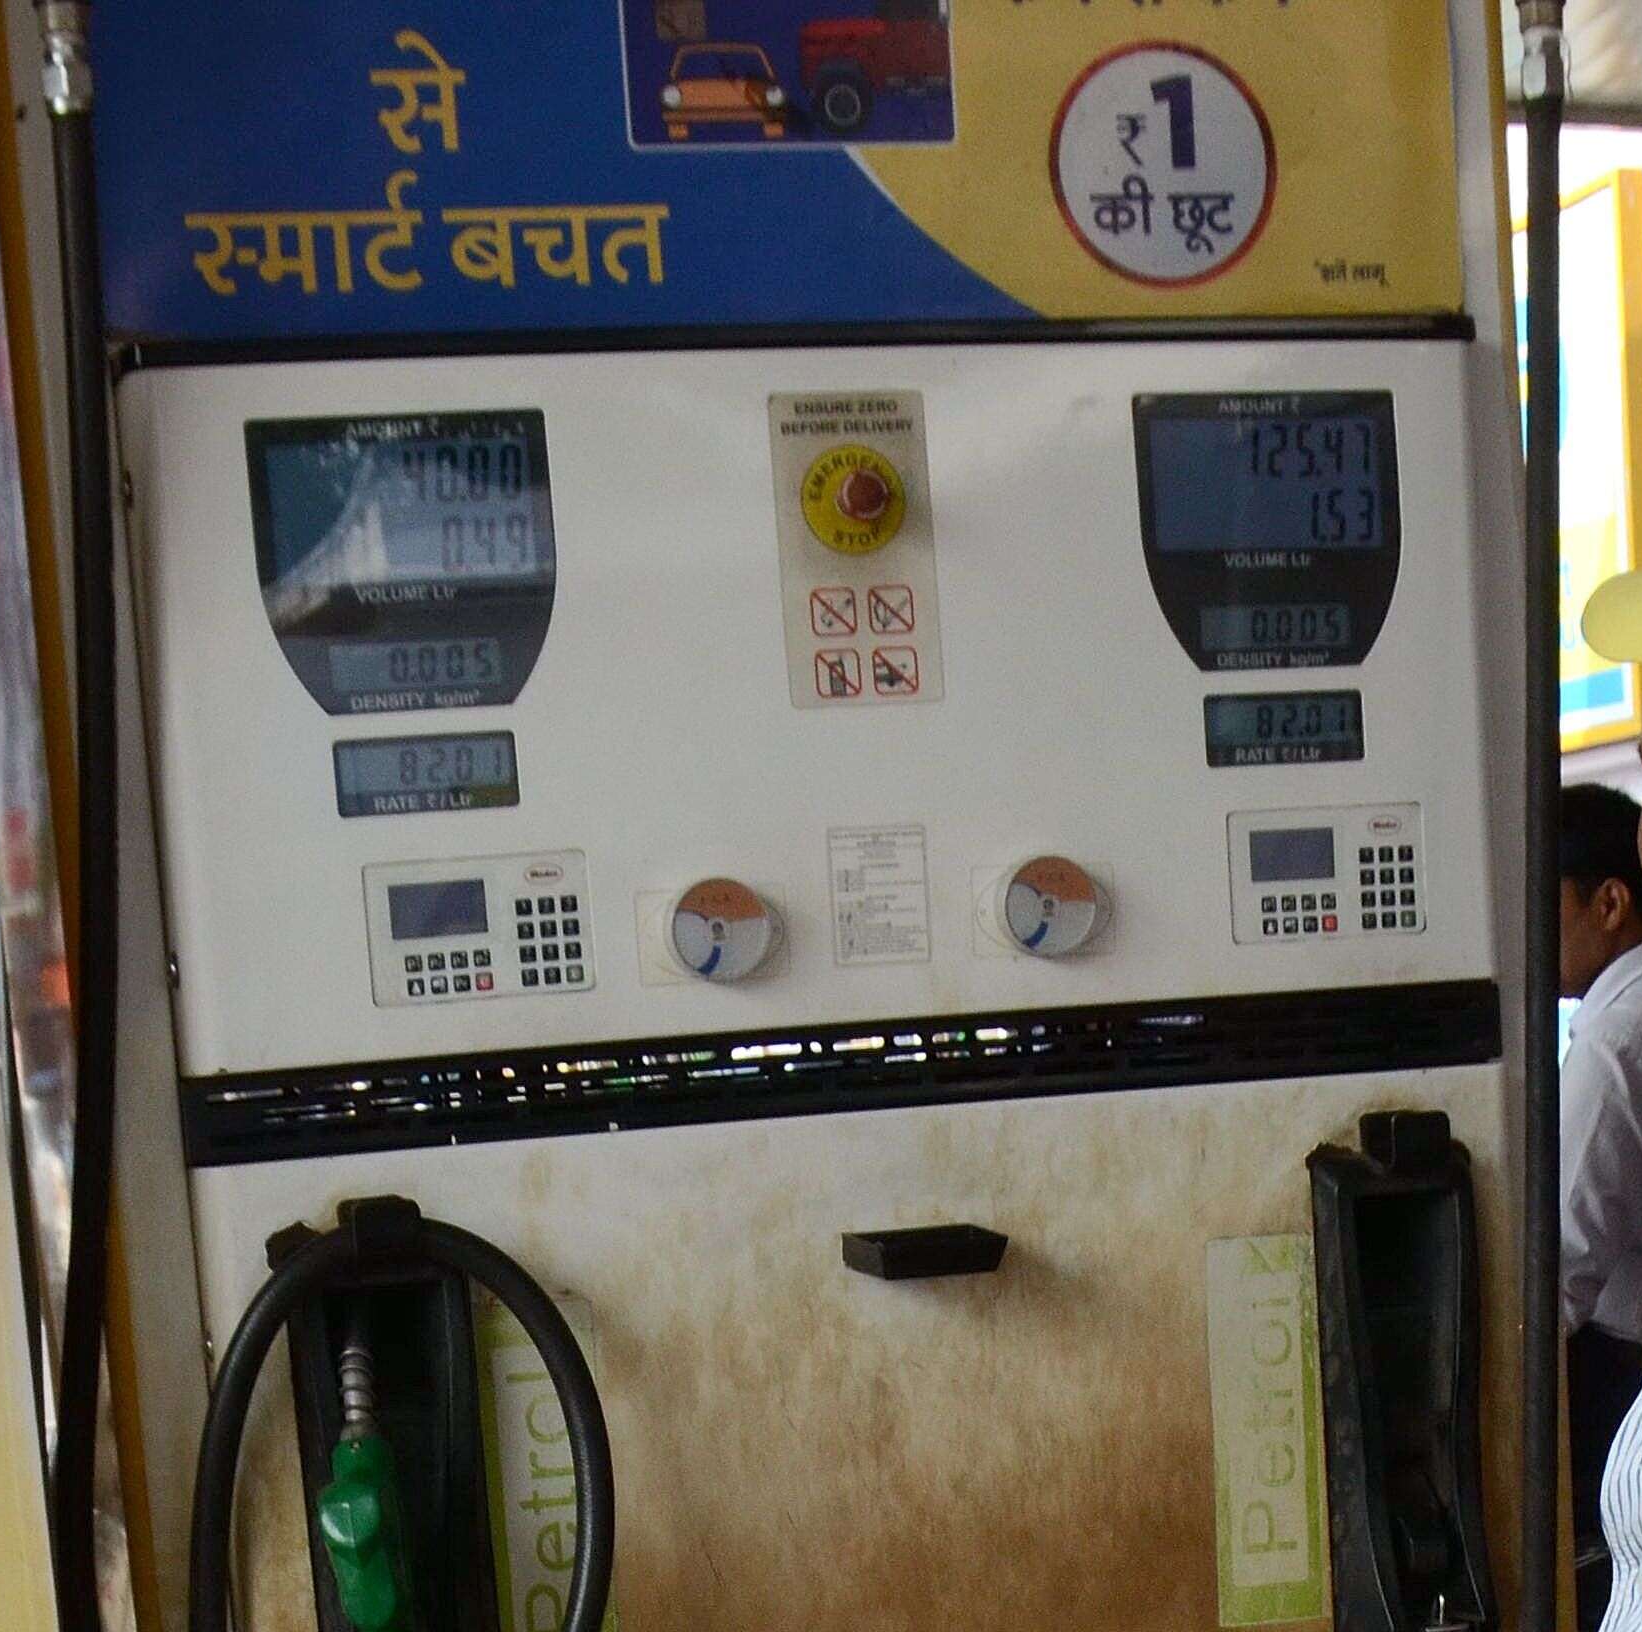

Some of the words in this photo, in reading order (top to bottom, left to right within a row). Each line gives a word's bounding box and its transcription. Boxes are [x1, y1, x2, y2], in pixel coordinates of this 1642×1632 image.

[368, 28, 467, 154] से
[1089, 174, 1154, 237] की
[1166, 190, 1235, 254] छूट
[184, 168, 425, 296] स्मार्ट
[441, 203, 671, 289] बचत
[794, 400, 853, 416] ENSURE
[857, 399, 899, 415] ZERO
[1218, 399, 1287, 415] AMOUNT
[781, 421, 839, 436] BEFORE
[843, 419, 914, 434] DELIVERY
[833, 524, 880, 546] STOP
[1225, 551, 1289, 569] VOLUME
[355, 583, 427, 603] VOLUME
[1217, 651, 1283, 667] DENSITY
[350, 691, 425, 711] DENSITY
[1235, 747, 1276, 764] RATE
[373, 794, 421, 813] RATE
[1241, 1297, 1299, 1556] Petrol
